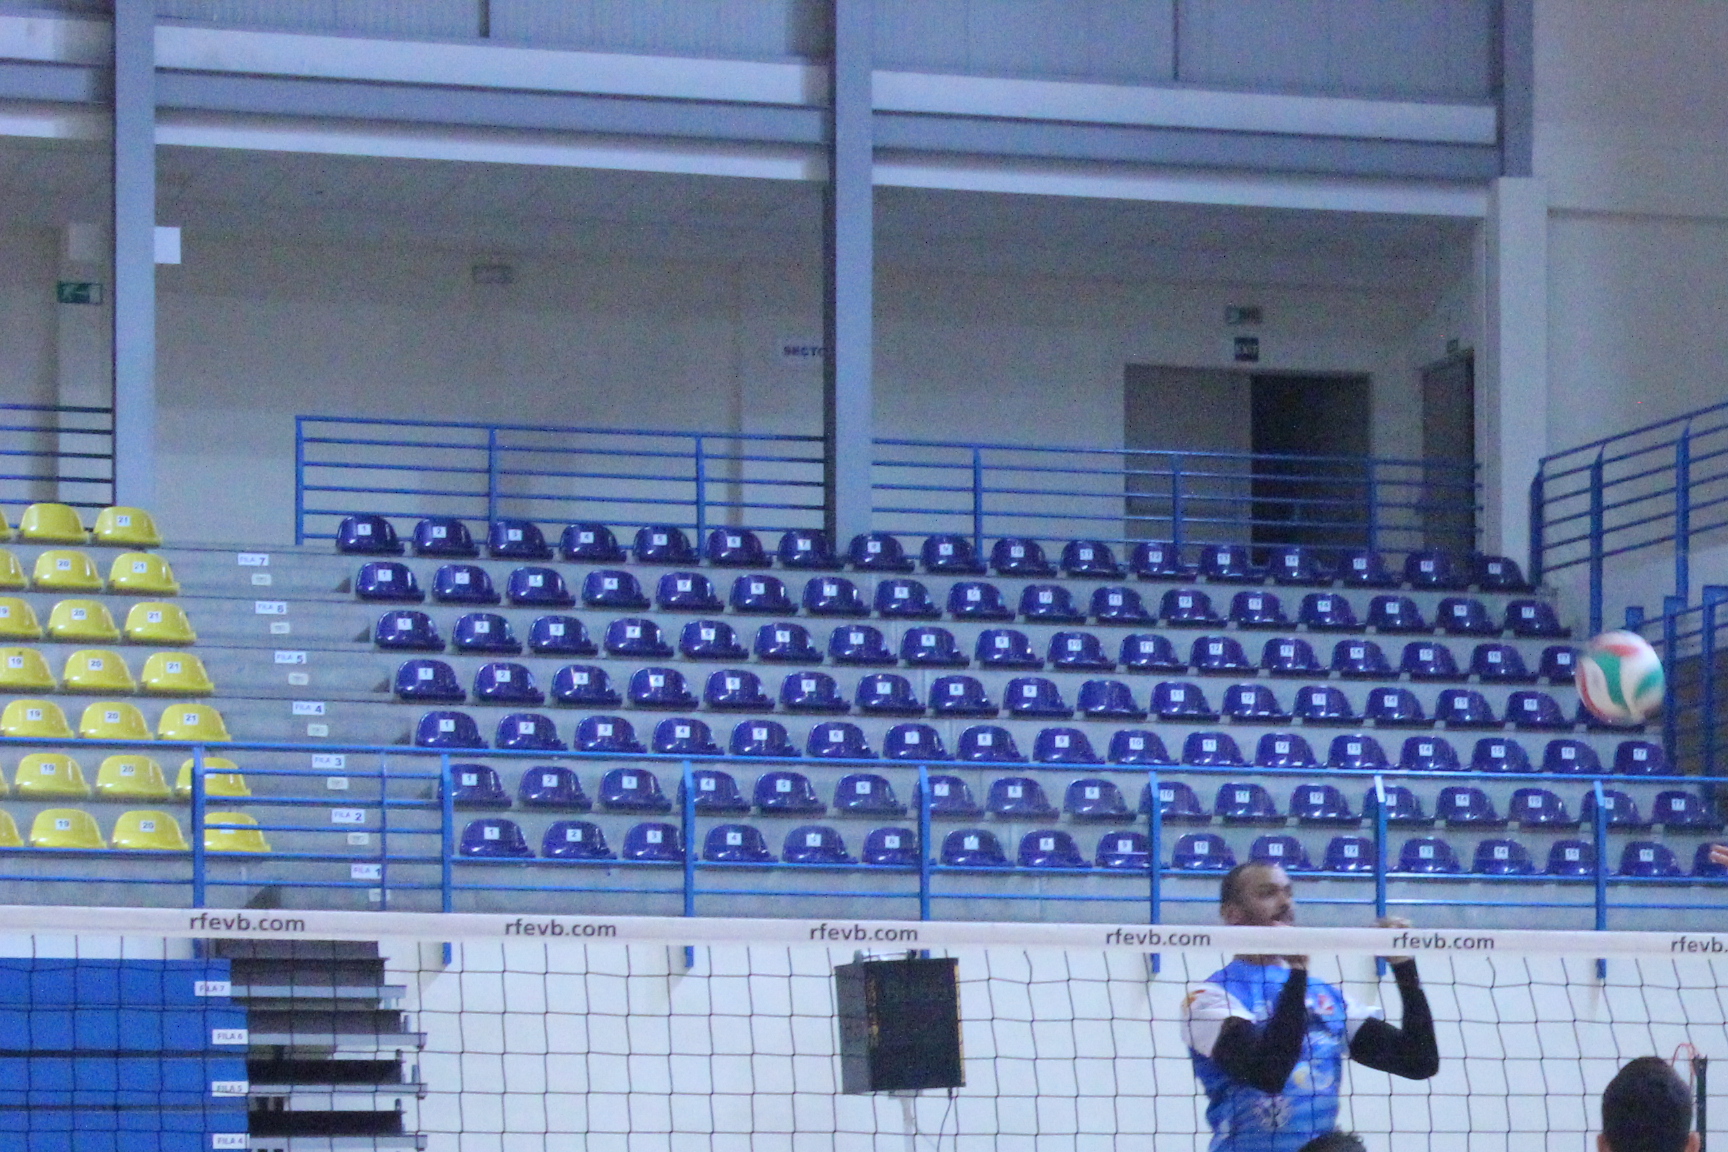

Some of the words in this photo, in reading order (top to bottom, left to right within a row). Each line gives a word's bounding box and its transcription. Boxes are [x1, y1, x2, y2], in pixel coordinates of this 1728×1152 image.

[190, 912, 305, 931] rfevb.com
[505, 918, 616, 937] rfevb.com
[810, 923, 918, 941] rfevb.com
[1106, 928, 1211, 946] rfevb.com
[1392, 932, 1495, 949] rfevb.com
